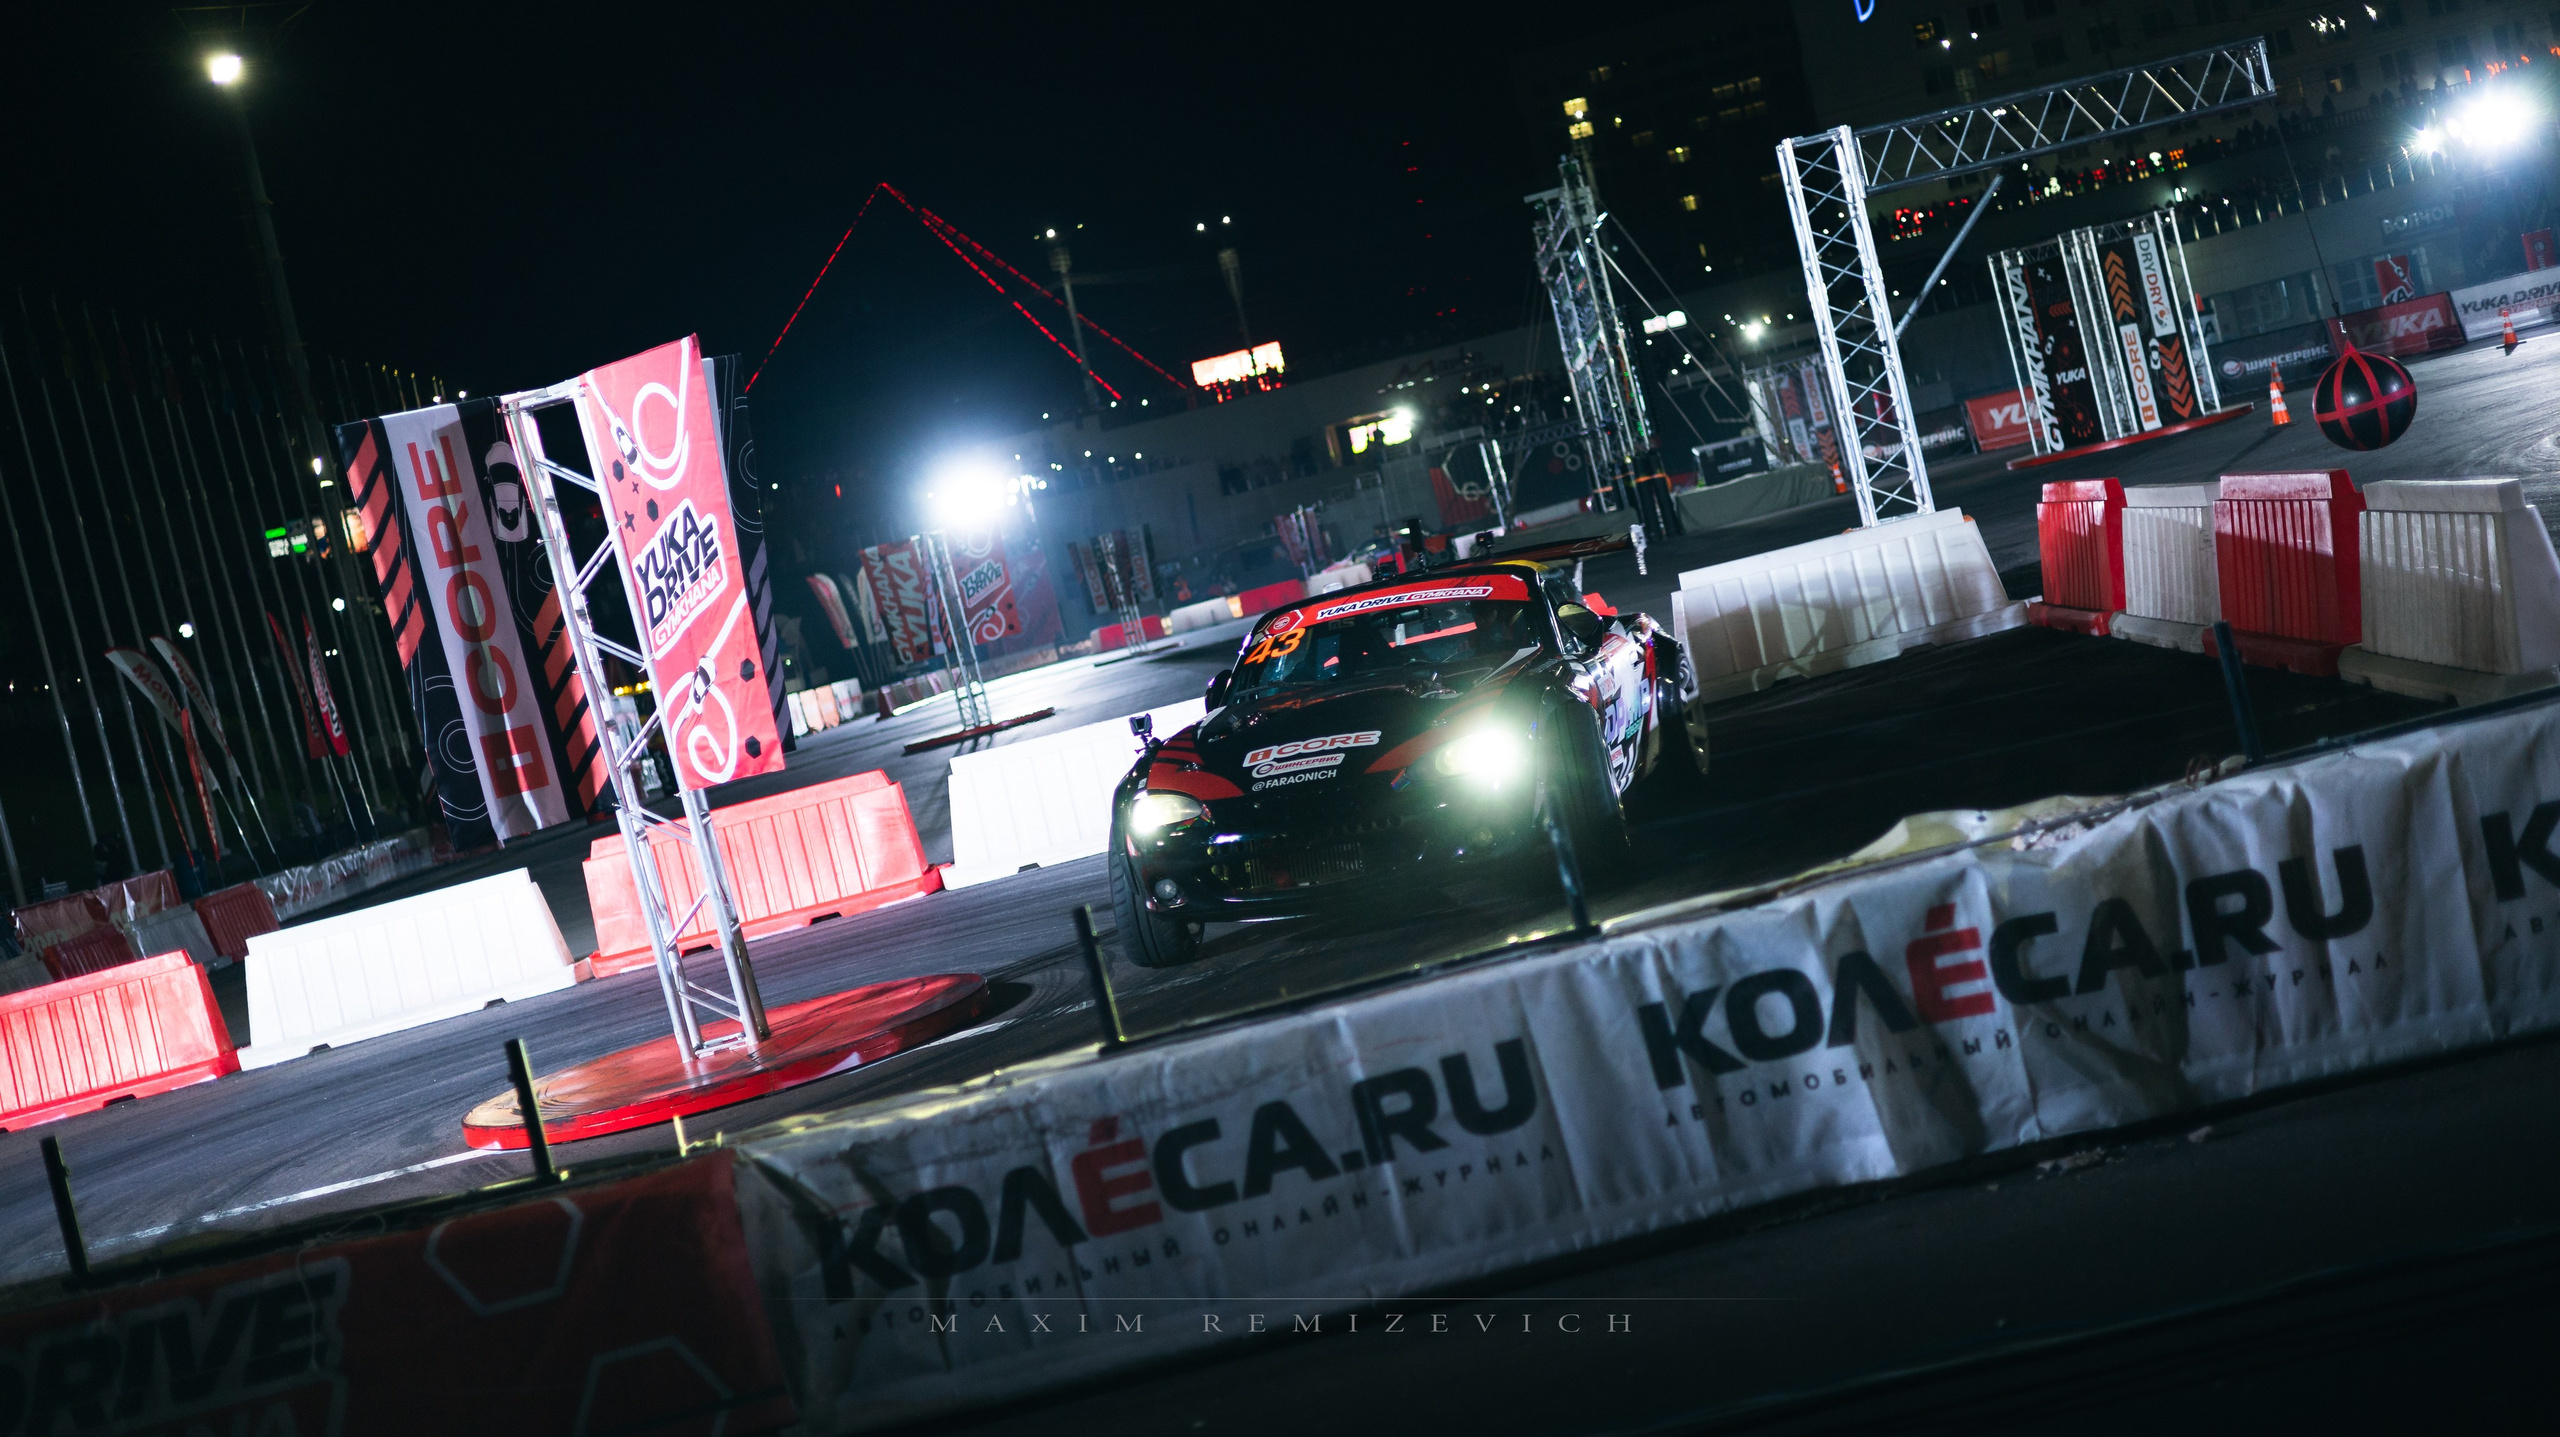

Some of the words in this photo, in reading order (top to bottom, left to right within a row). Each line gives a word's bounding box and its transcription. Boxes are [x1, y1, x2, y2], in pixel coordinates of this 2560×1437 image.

[2349, 307, 2445, 347] YUKA
[2461, 293, 2508, 313] YUKA
[2512, 281, 2560, 305] DRIV
[2008, 266, 2065, 452] GYMKHANA
[2055, 366, 2087, 386] YUKA
[635, 505, 700, 596] YUKA
[646, 521, 719, 631] DRIVE
[654, 565, 722, 646] GYMKHANA
[865, 547, 913, 664] GYMKHANA
[886, 551, 928, 646] YUKA
[1320, 604, 1357, 618] YUKA
[1358, 595, 1408, 609] DRIVE
[1409, 586, 1485, 601] GYMKHANA
[1244, 626, 1307, 666] 43
[1252, 768, 1338, 792] @FARAONICH
[1273, 754, 1342, 771] ШИНСЕРВИС
[1667, 1029, 2014, 1128] АВТОМОБИЛЬНЫЙ
[2046, 951, 2389, 1041] ОНЛАЙН-ЖУРНАЛ
[1213, 1143, 1555, 1246] ОНЛАЙН-ЖУРНАЛ
